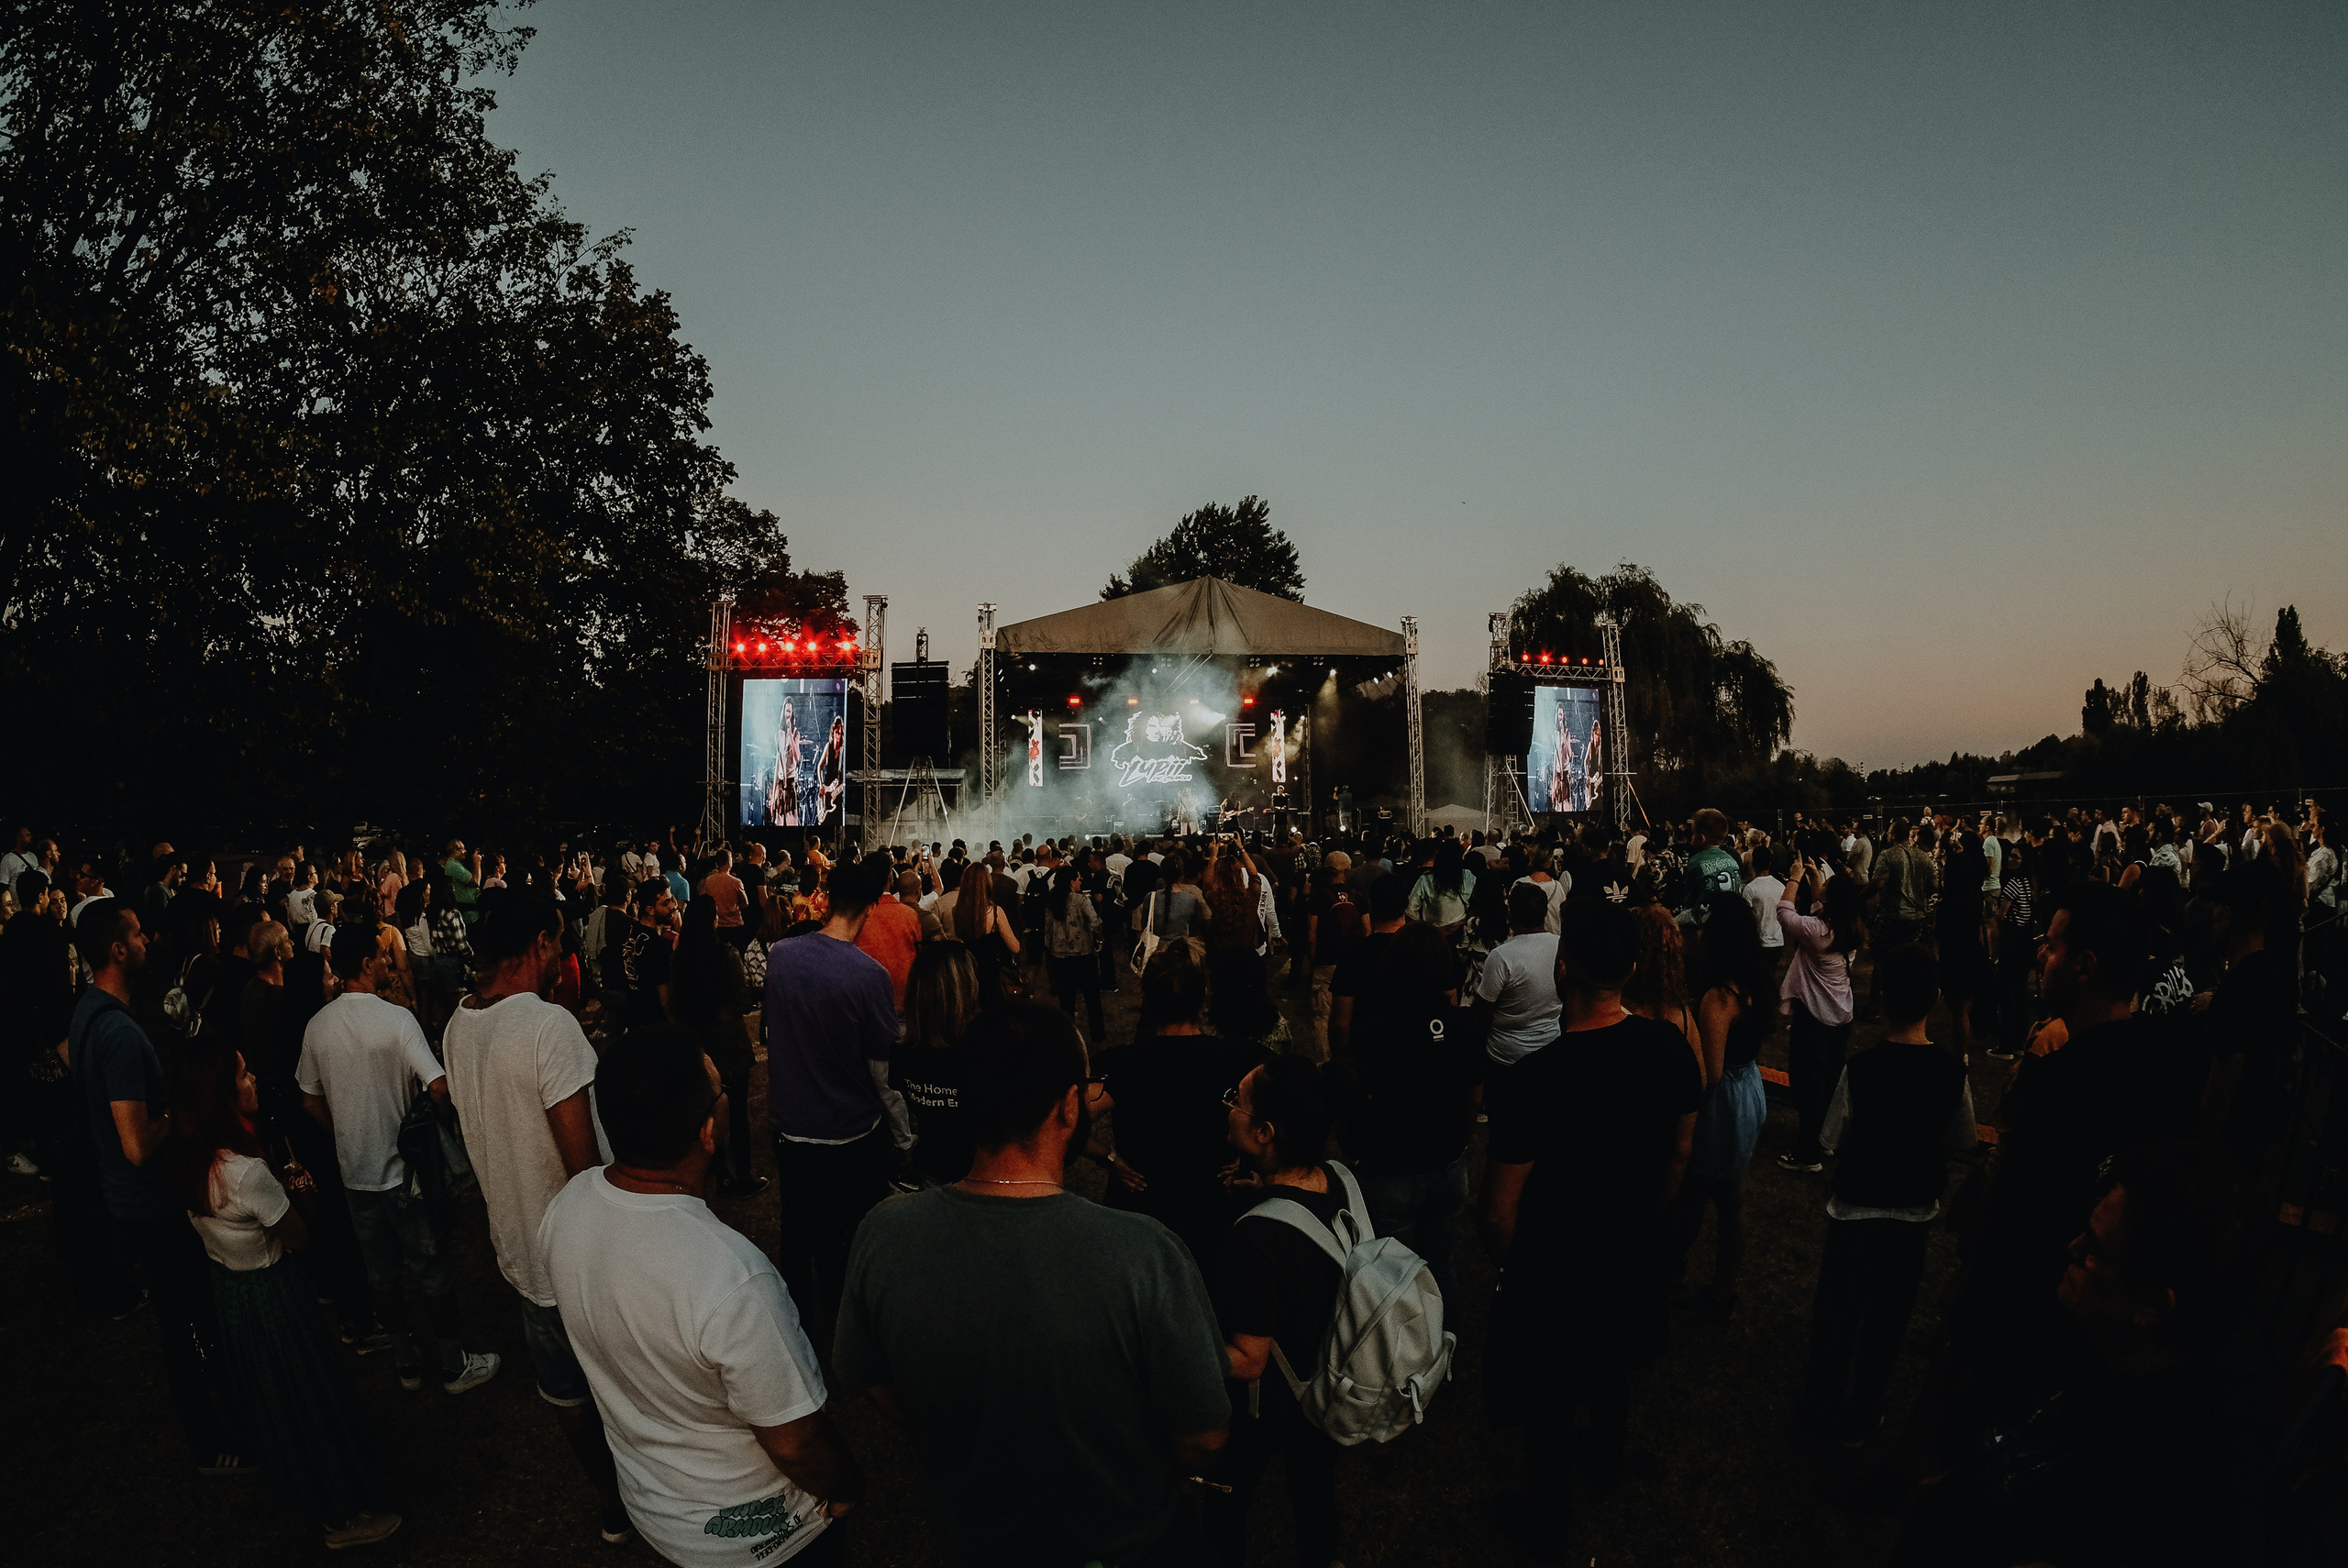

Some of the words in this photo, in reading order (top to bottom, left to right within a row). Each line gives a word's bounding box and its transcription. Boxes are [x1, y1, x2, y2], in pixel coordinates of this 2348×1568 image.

[904, 1078, 922, 1092] The
[924, 1083, 958, 1096] Home
[719, 1495, 786, 1518] UNDER
[703, 1512, 789, 1538] ARMOUR
[793, 1510, 803, 1525] OF
